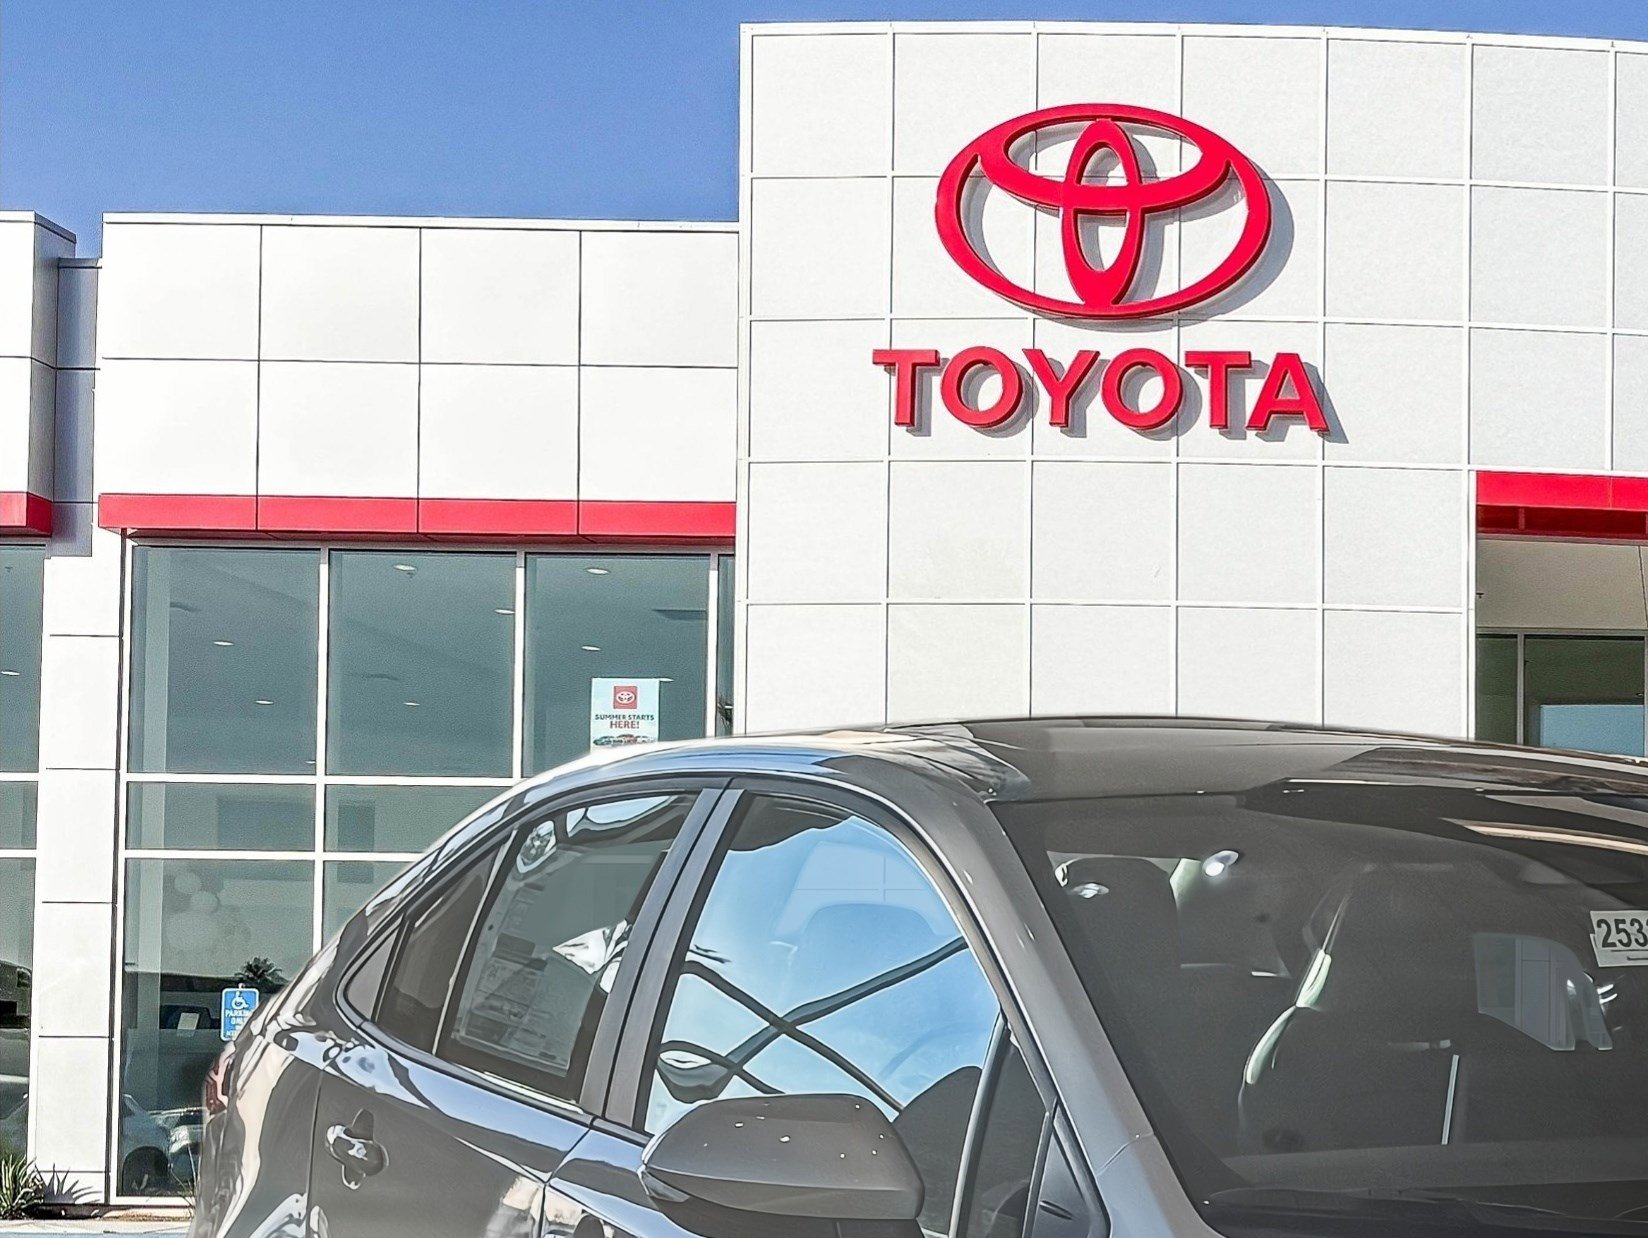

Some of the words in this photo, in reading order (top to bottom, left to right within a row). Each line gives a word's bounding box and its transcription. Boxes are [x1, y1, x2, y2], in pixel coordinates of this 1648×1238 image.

[872, 345, 1330, 432] TOYOTA
[594, 713, 627, 721] SUMMER
[628, 713, 655, 721] STARTS
[610, 720, 640, 729] HERE!
